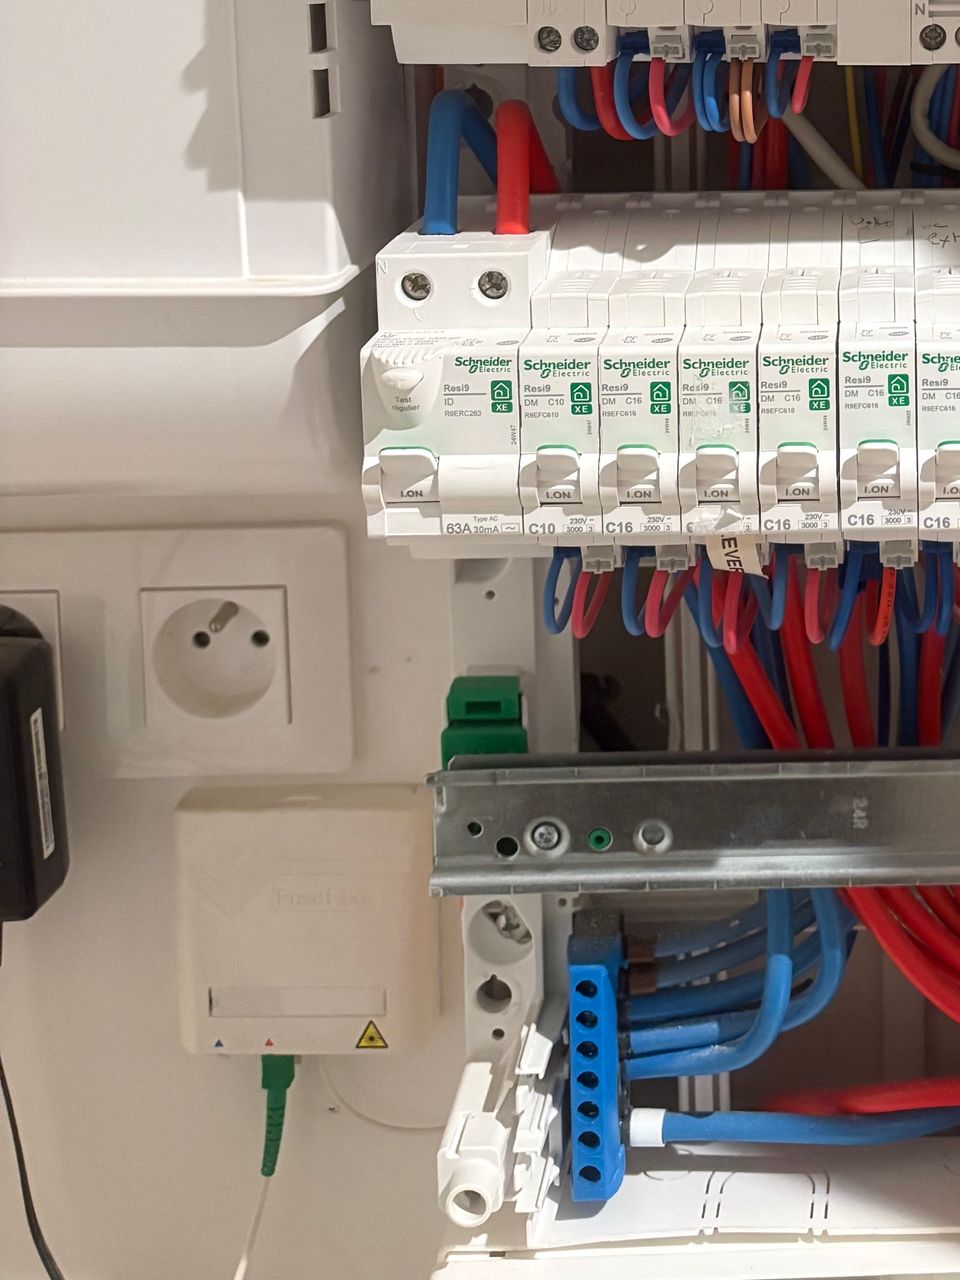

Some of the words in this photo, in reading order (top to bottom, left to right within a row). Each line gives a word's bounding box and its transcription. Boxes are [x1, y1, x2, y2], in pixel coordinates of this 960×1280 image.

[455, 356, 512, 368] Schneider
[762, 356, 829, 367] Schneider
[842, 351, 909, 363] Schneider
[523, 359, 591, 371] Schneider
[603, 358, 670, 370] Schneider
[682, 359, 750, 370] Schneider
[601, 384, 629, 392] Resi9
[921, 378, 949, 387] Resi9
[443, 384, 470, 393] Resi9
[496, 404, 508, 412] XE
[653, 405, 667, 413] XE
[812, 401, 826, 409] XE
[400, 490, 423, 498] I.ON
[626, 490, 652, 498] I.ON
[785, 488, 810, 496] I.ON
[864, 486, 889, 494] I.ON
[763, 519, 791, 531] C16
[847, 514, 875, 526] C16
[923, 517, 951, 529] C16
[446, 522, 472, 534] 63A
[473, 525, 499, 534] 30mA
[528, 523, 555, 534] C10
[606, 521, 633, 533] C16
